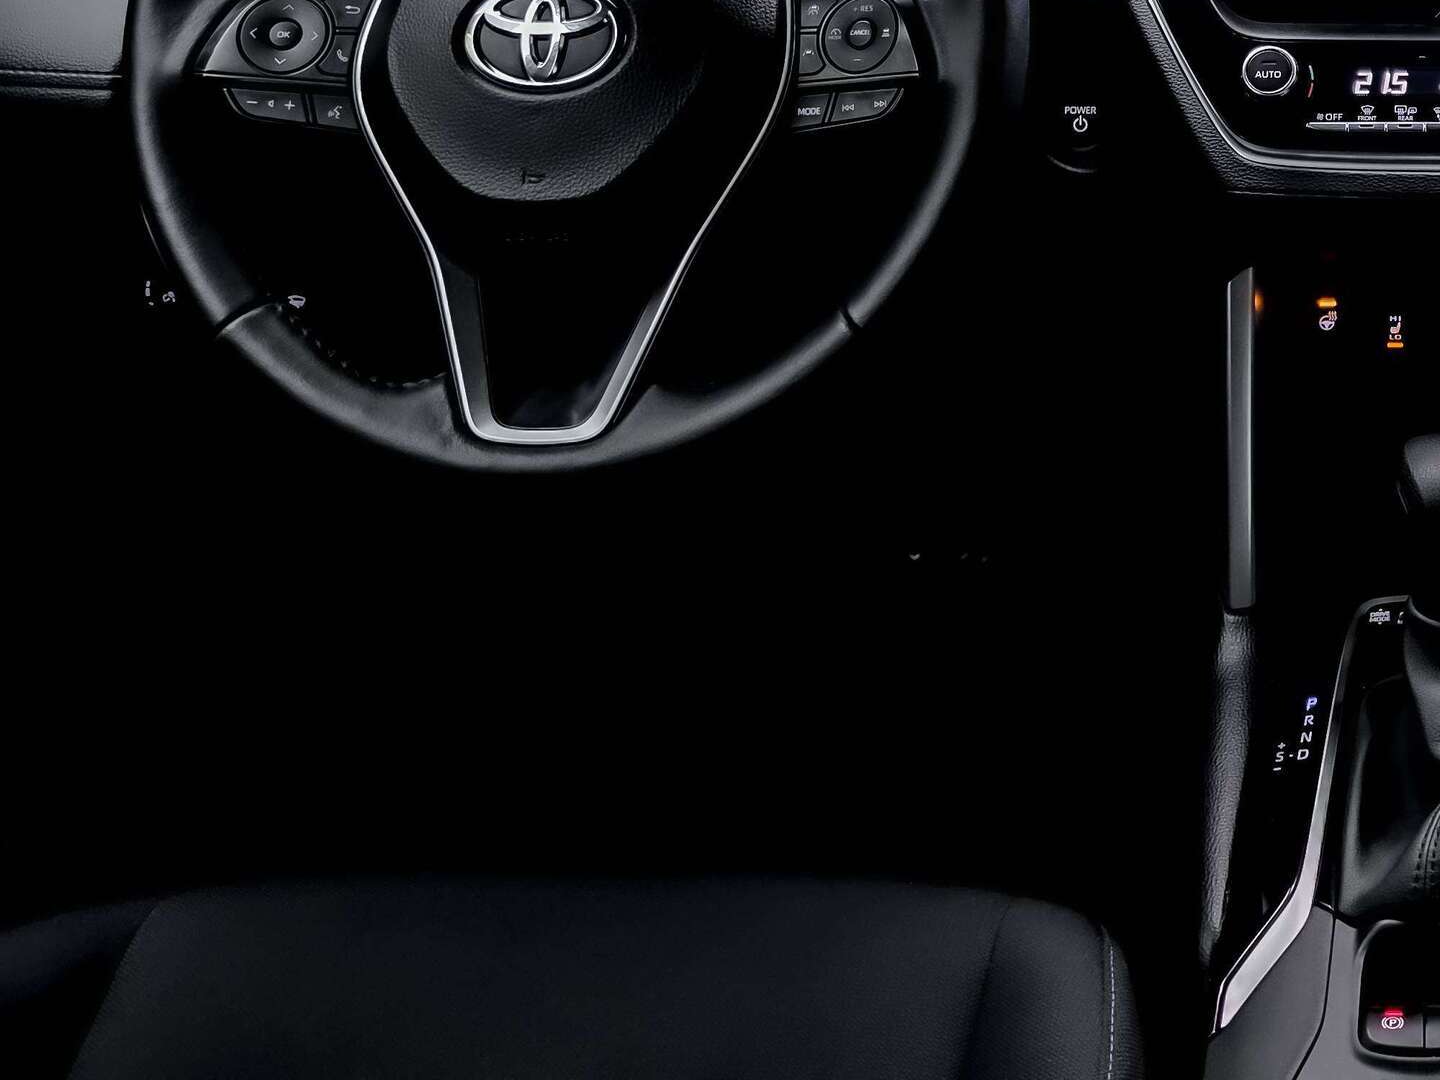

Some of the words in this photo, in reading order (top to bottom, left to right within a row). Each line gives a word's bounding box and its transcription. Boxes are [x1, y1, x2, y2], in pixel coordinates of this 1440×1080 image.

[276, 30, 291, 38] OK
[1254, 70, 1282, 79] AUTO
[797, 106, 821, 116] MODE
[1064, 106, 1097, 114] POWER
[1325, 113, 1343, 121] OFF
[1306, 697, 1318, 711] P
[1303, 714, 1314, 726] R
[1300, 731, 1312, 743] N
[1275, 751, 1285, 762] S
[1297, 748, 1309, 760] D
